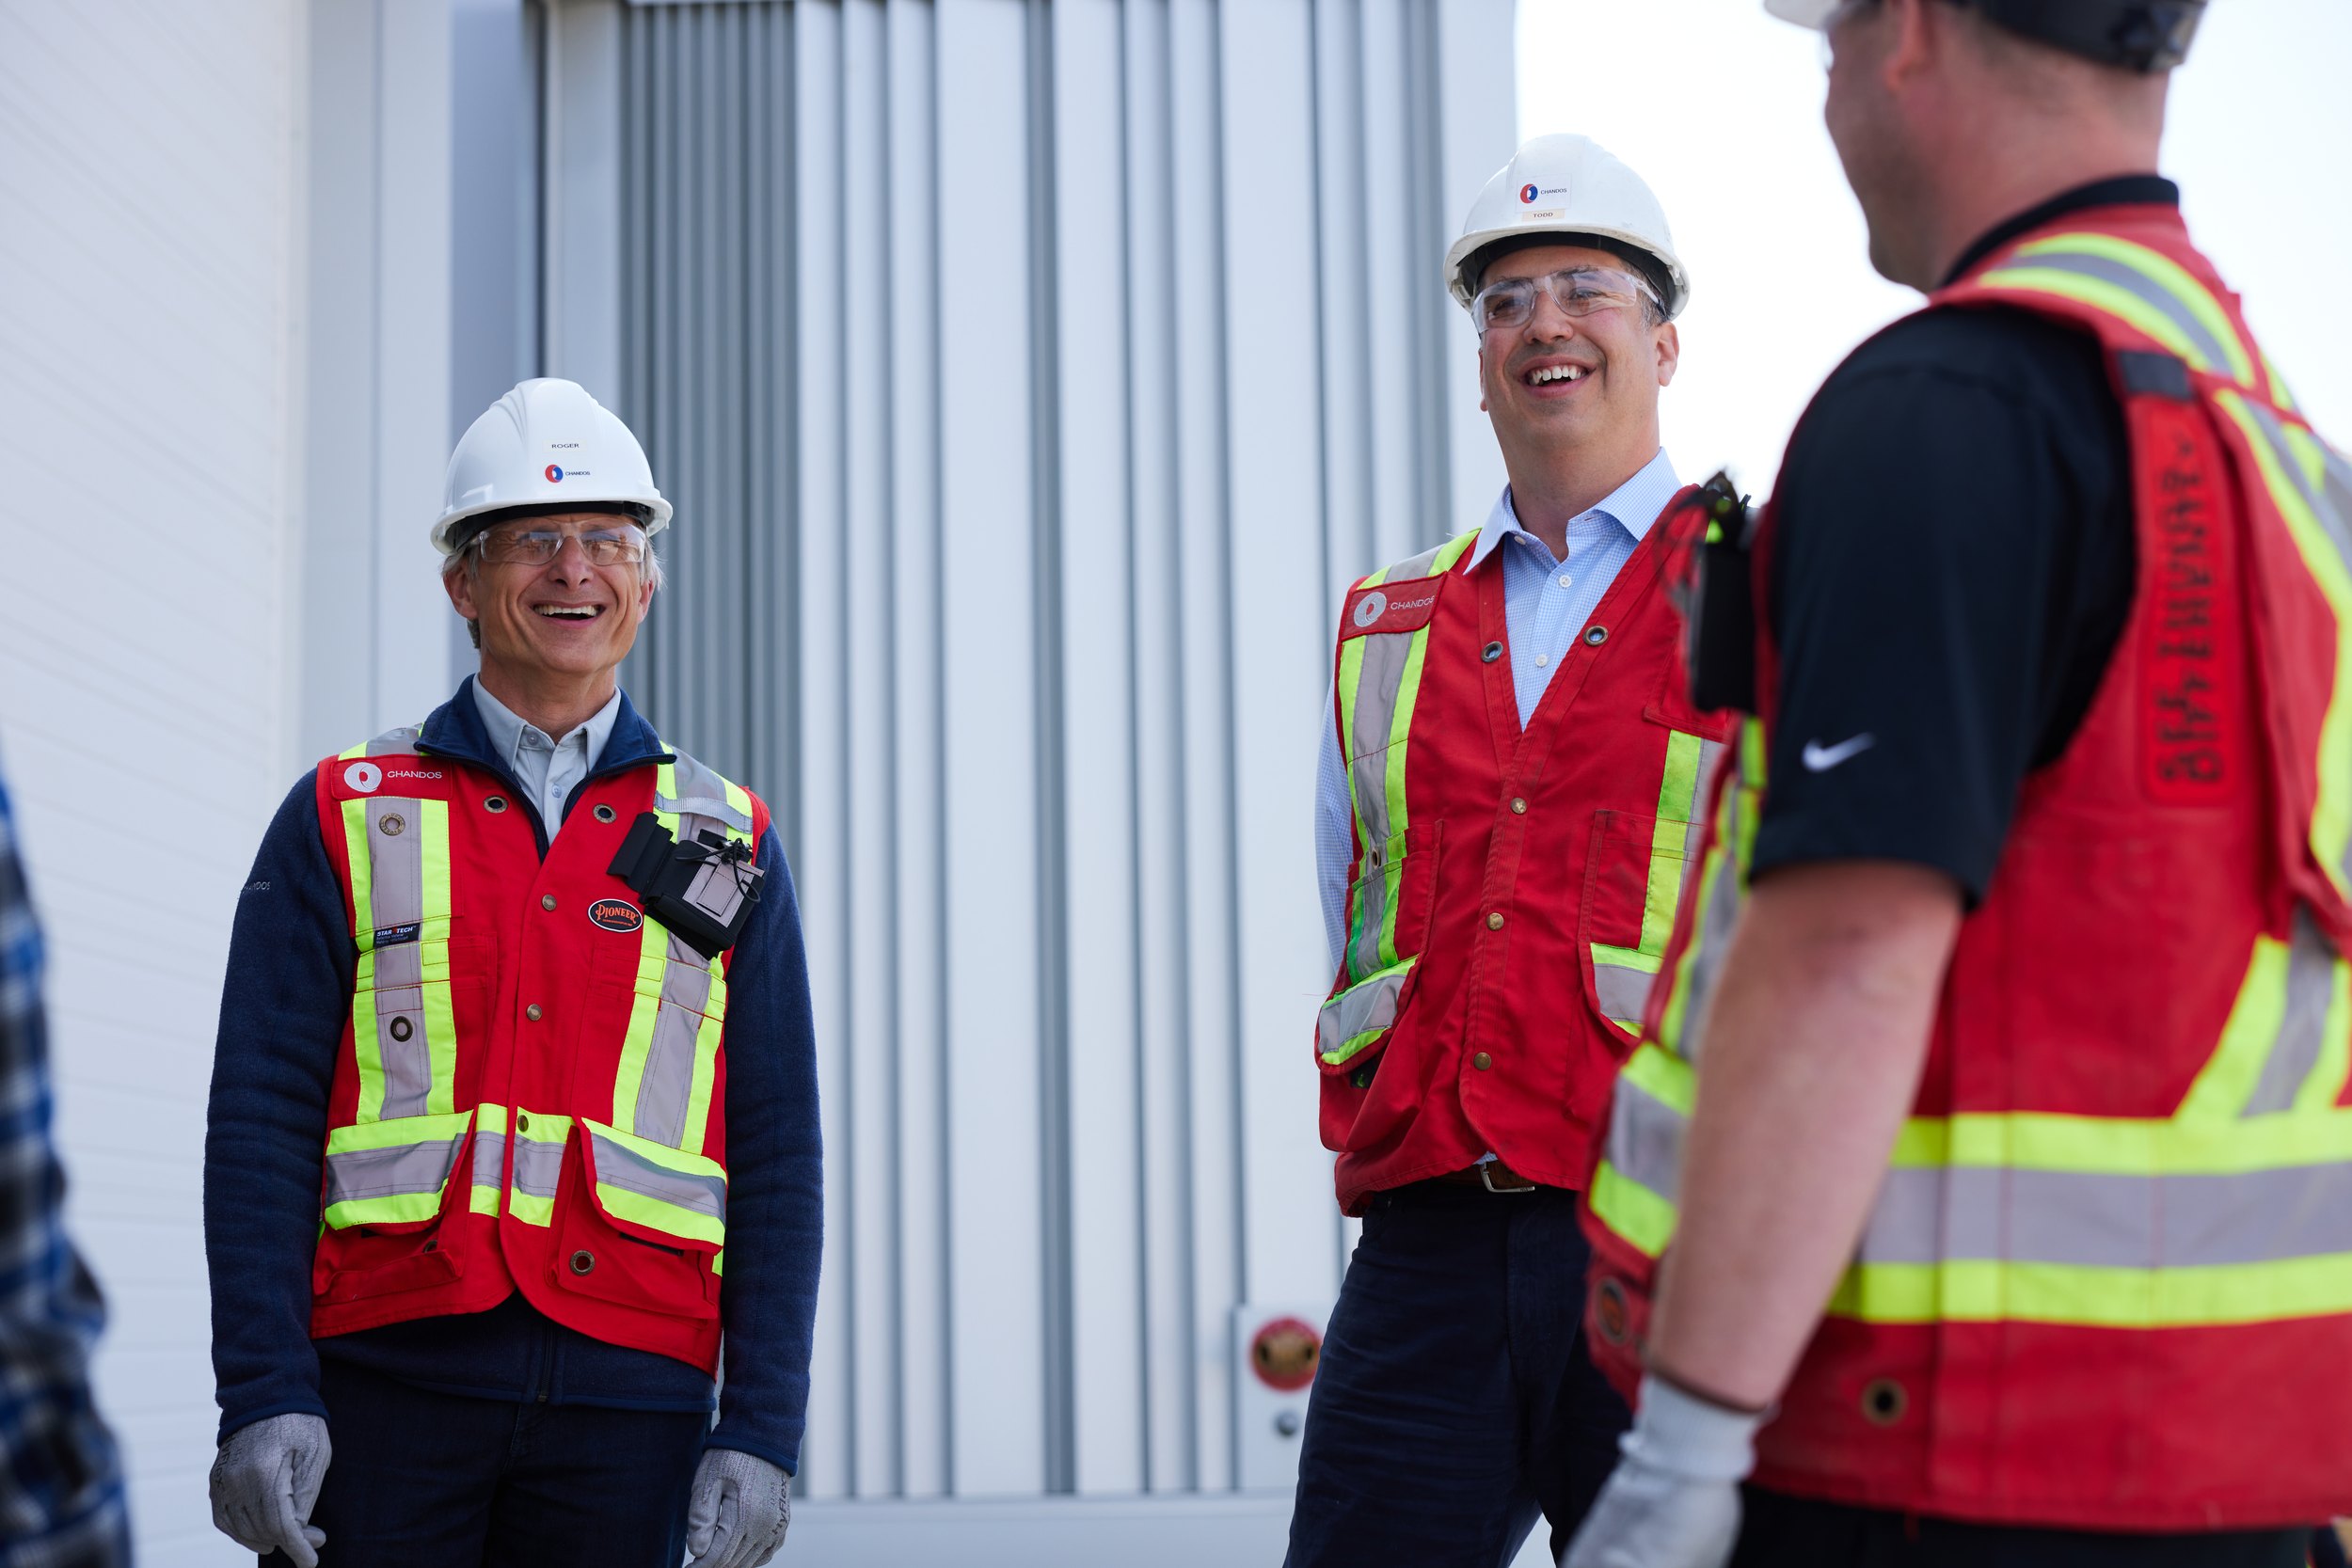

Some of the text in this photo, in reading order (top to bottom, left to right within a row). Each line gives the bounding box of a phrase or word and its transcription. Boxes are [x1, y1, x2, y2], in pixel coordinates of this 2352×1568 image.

[1390, 594, 1435, 610] CHANDOS
[387, 770, 442, 780] CHANDOS
[595, 903, 637, 925] PIONEER
[771, 1479, 787, 1535] HyFlex
